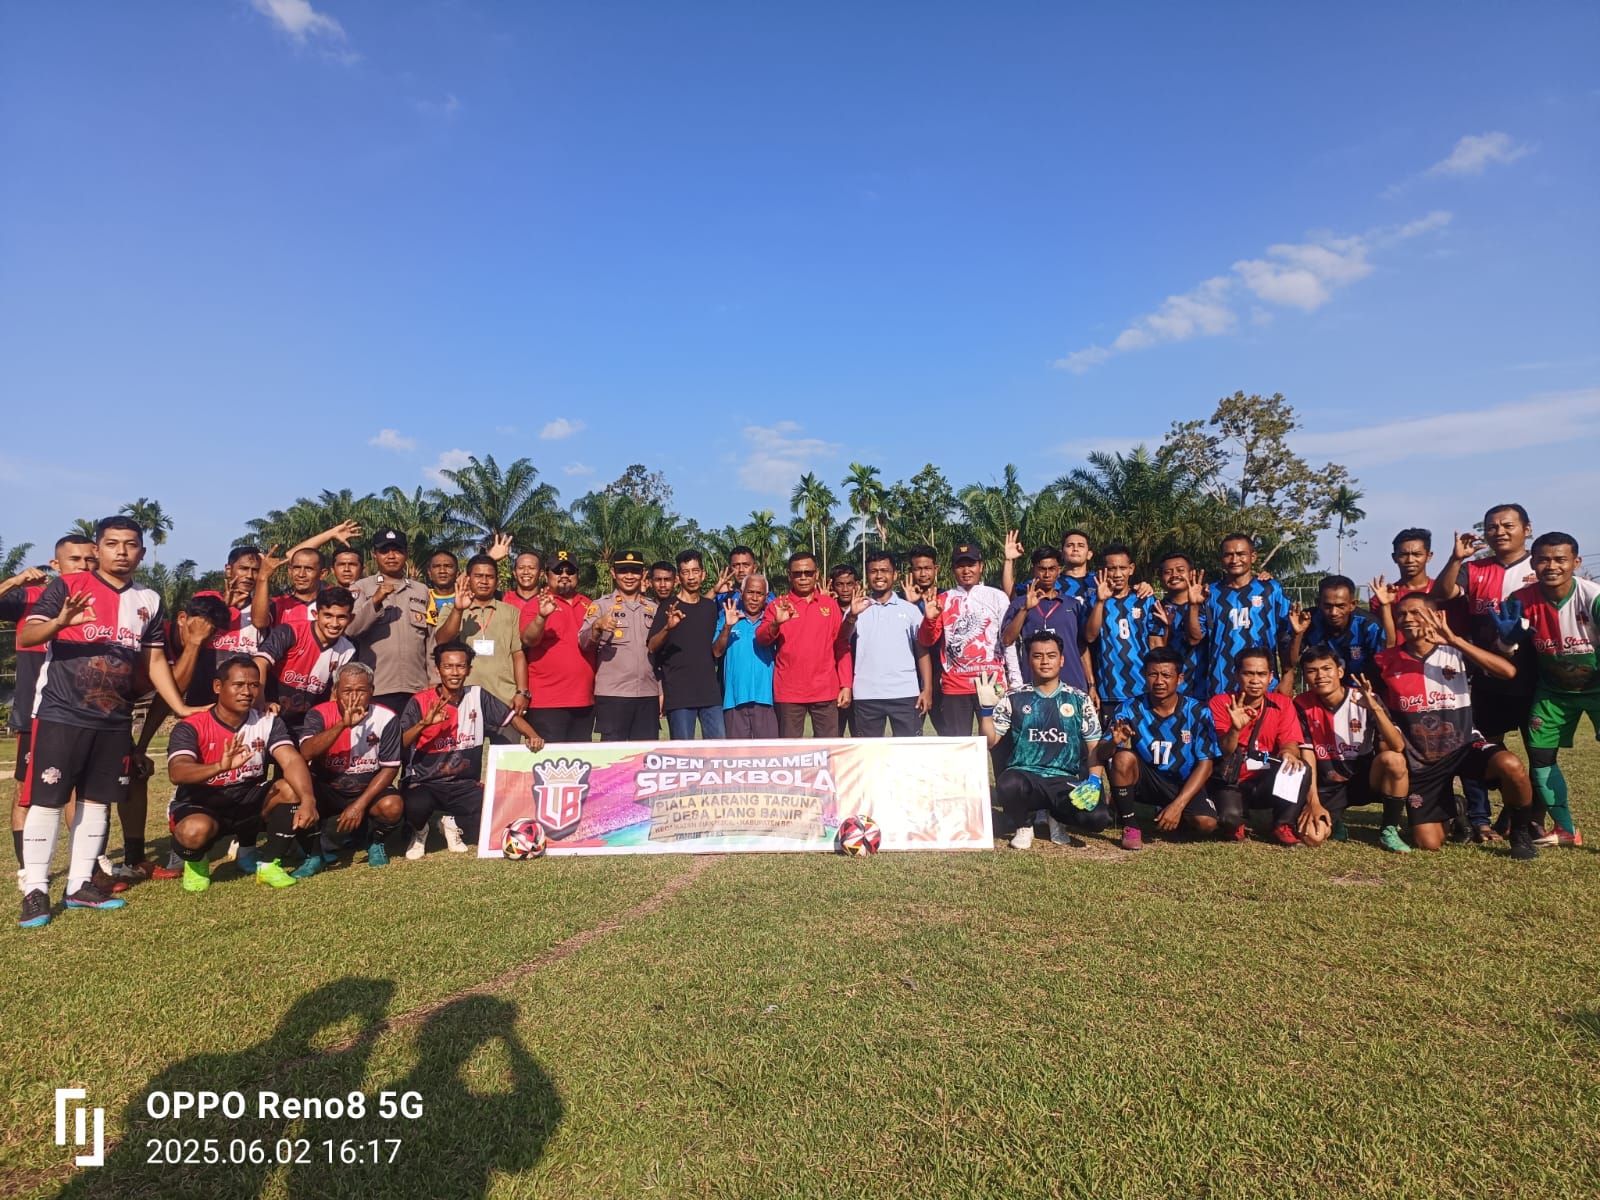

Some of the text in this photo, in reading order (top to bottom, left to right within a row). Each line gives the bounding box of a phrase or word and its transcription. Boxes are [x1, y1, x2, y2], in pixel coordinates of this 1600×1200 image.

[1118, 618, 1130, 640] 8
[1228, 606, 1251, 631] 14
[83, 623, 113, 641] Old
[1399, 694, 1424, 712] Old
[1427, 690, 1457, 706] Stars
[1028, 727, 1069, 745] ExSa
[646, 750, 829, 770] OPEN TURNAMEN
[1150, 740, 1173, 765] 17
[636, 768, 837, 797] SEPAKBOLA
[655, 794, 820, 813] PIALA KARANG TARUNA
[672, 806, 803, 823] DESA LIANG BANIR
